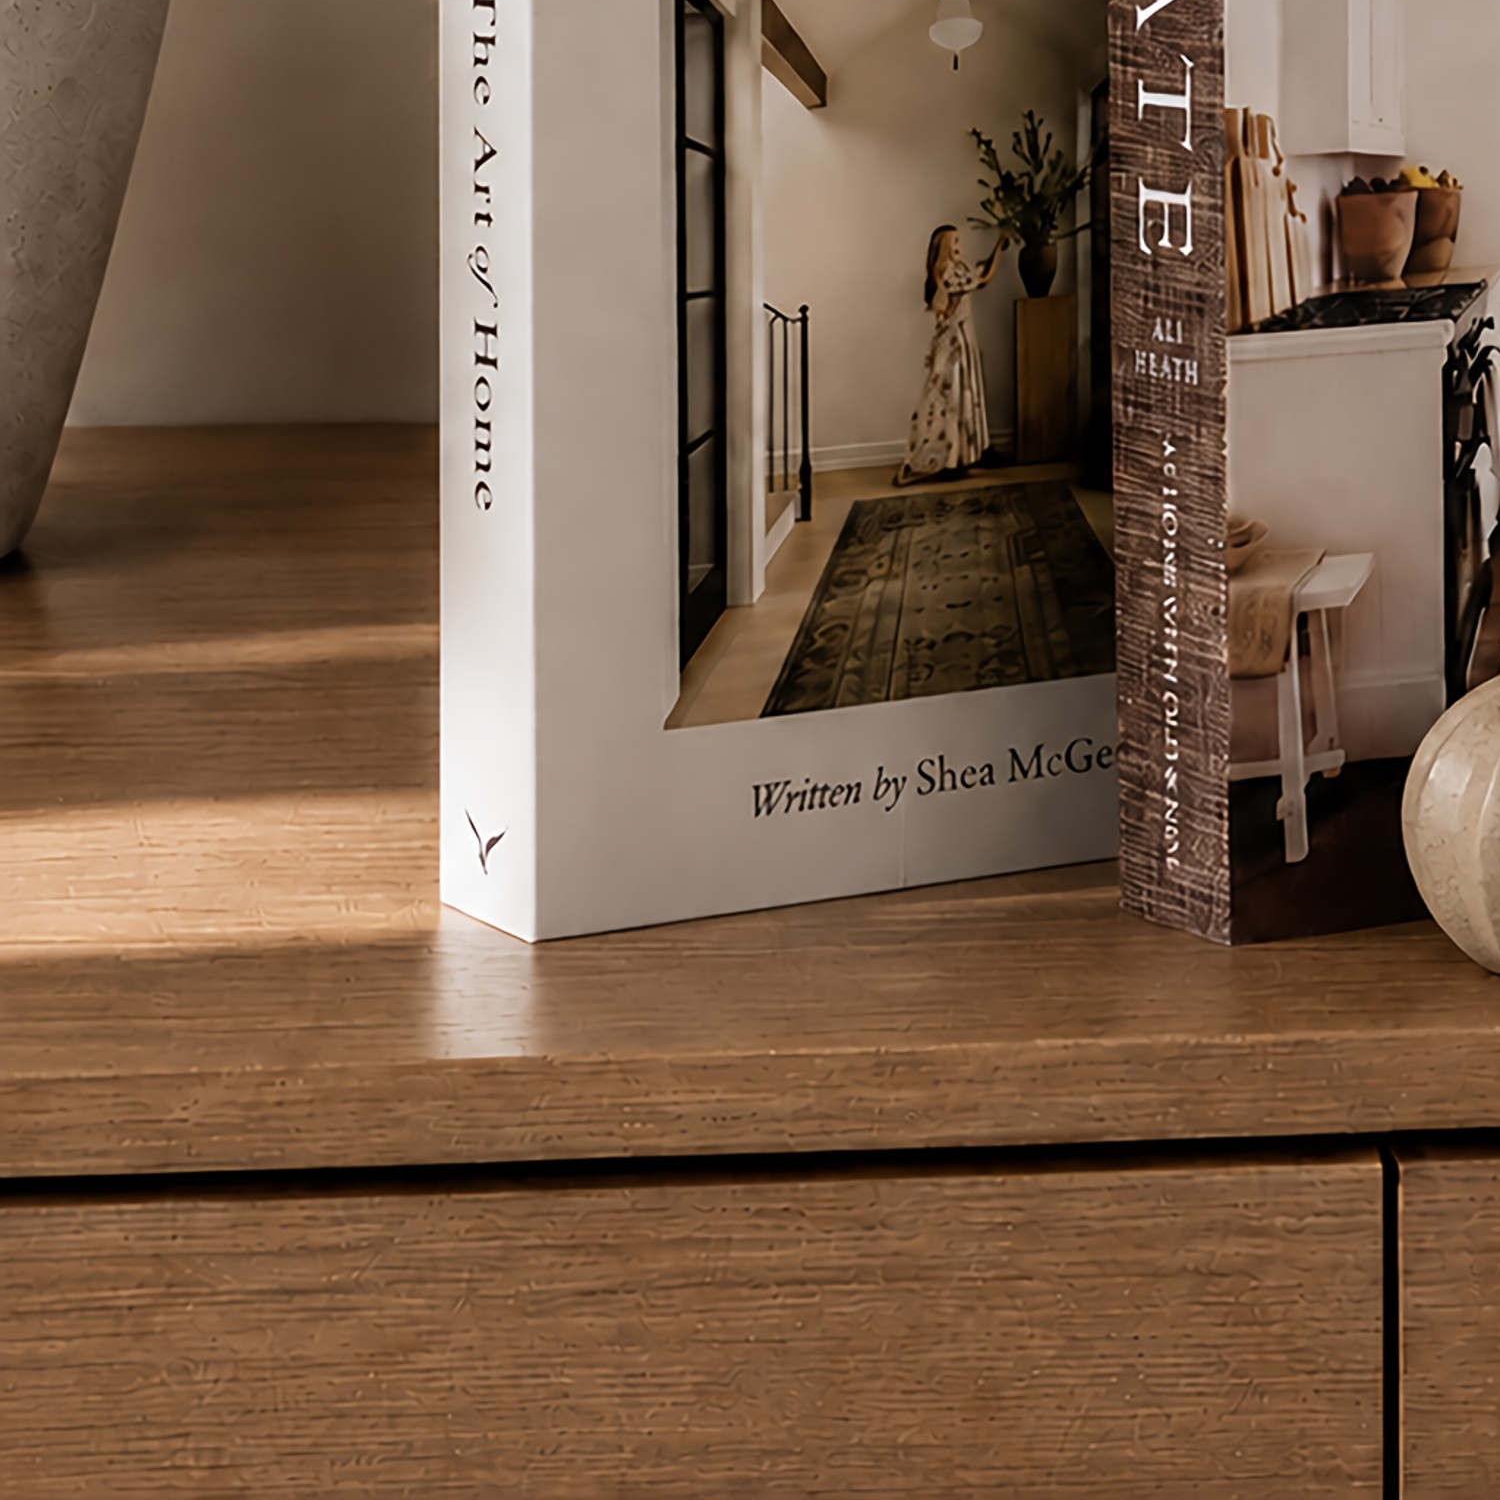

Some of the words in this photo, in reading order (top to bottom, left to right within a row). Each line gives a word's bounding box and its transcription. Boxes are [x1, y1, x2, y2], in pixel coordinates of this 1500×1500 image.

[474, 127, 498, 227] Art
[467, 245, 499, 309] of
[1152, 317, 1183, 345] ALI
[1135, 349, 1198, 386] HEATH
[474, 320, 498, 512] Home
[752, 777, 863, 818] Written
[872, 766, 907, 812] by
[916, 754, 996, 796] Shea
[1008, 738, 1118, 783] McGe
